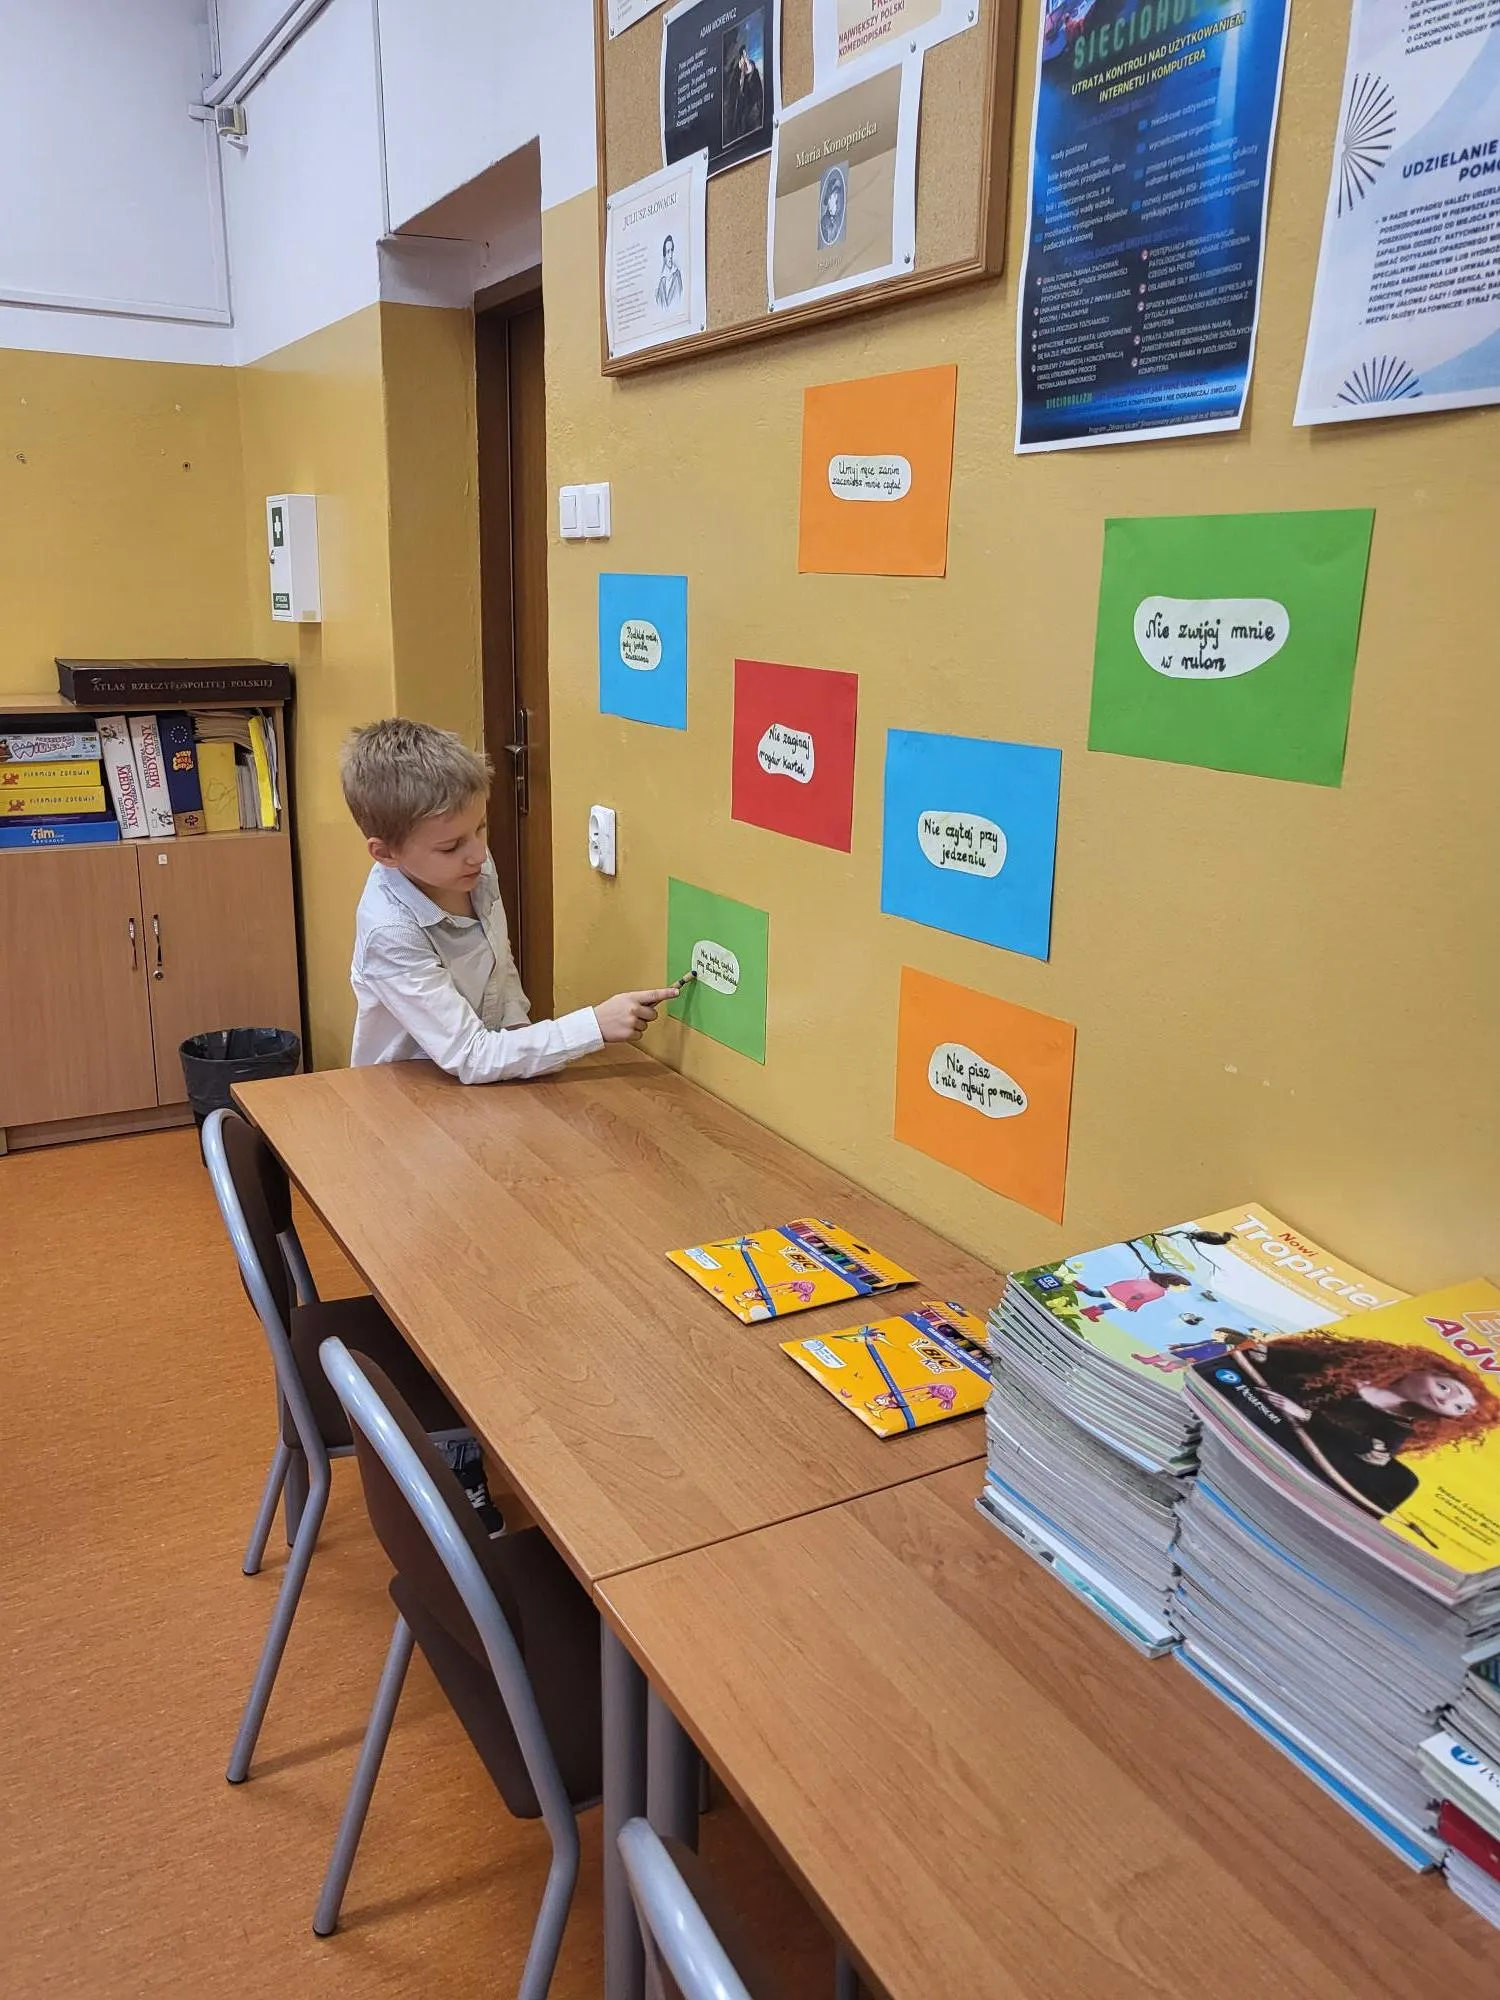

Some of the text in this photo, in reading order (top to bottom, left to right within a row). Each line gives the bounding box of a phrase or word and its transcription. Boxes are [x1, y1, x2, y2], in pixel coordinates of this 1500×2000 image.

[839, 14, 878, 44] NAJWIĘKSZY
[880, 0, 904, 21] POLSKI
[1073, 0, 1200, 70] SIECIOHOL
[838, 21, 892, 57] KOMEDIOPISARZ
[1072, 10, 1246, 96] UTRATA KONTROLI NAD UŻYTKOWANIEM
[1405, 38, 1442, 55] NARAŻONE
[1443, 34, 1453, 42] NA
[1099, 76, 1145, 104] INTERNETU
[1152, 48, 1206, 82] KOMPUTERA
[796, 120, 878, 168] Maria Konopnicka
[1402, 139, 1499, 180] UDZIELANIE
[622, 192, 677, 232] JULIUSZ SŁOWACKI
[1410, 201, 1443, 215] WYPADKU
[1444, 192, 1471, 206] NALEŻY
[1450, 200, 1489, 216] PIERWSZEJ
[1378, 224, 1443, 246] POSZKODOWANEGO
[1456, 214, 1487, 226] MIEJSCA
[1445, 222, 1495, 240] NATYCHMIAST
[1455, 252, 1469, 261] LUB
[1370, 280, 1400, 291] PETARDA
[1444, 266, 1458, 276] LUB
[1460, 259, 1490, 272] URWAŁA
[1404, 284, 1428, 295] PONAD
[1485, 270, 1495, 278] NA
[1368, 303, 1394, 314] WARSTW
[1429, 292, 1447, 301] GAZY
[1466, 294, 1490, 306] STRAŻ
[838, 460, 900, 480] Umyj ręce zanim
[864, 480, 880, 488] mnie
[1146, 612, 1276, 650] Nie zwijaj mnie
[1161, 650, 1226, 672] w rulon
[92, 678, 125, 691] ATLAS
[230, 679, 273, 688] POLSKIEJ
[140, 724, 160, 789] MEDYCYNY
[769, 724, 811, 760] Nie zaginaj
[760, 750, 780, 769] rogów
[116, 765, 139, 829] MEDYCYNY
[31, 828, 55, 840] film
[924, 818, 998, 853] Nie czytaj przy
[940, 844, 986, 868] jedzeniu
[947, 1052, 991, 1082] Nie pisz
[941, 1075, 956, 1088] nie
[961, 1083, 985, 1105] rysuj
[988, 1088, 997, 1107] po
[1000, 1089, 1023, 1105] mnie
[790, 1254, 818, 1269] BIC
[1232, 1213, 1400, 1311] Tropiciel
[921, 1348, 960, 1368] BIC
[1235, 1384, 1282, 1424] Pearson
